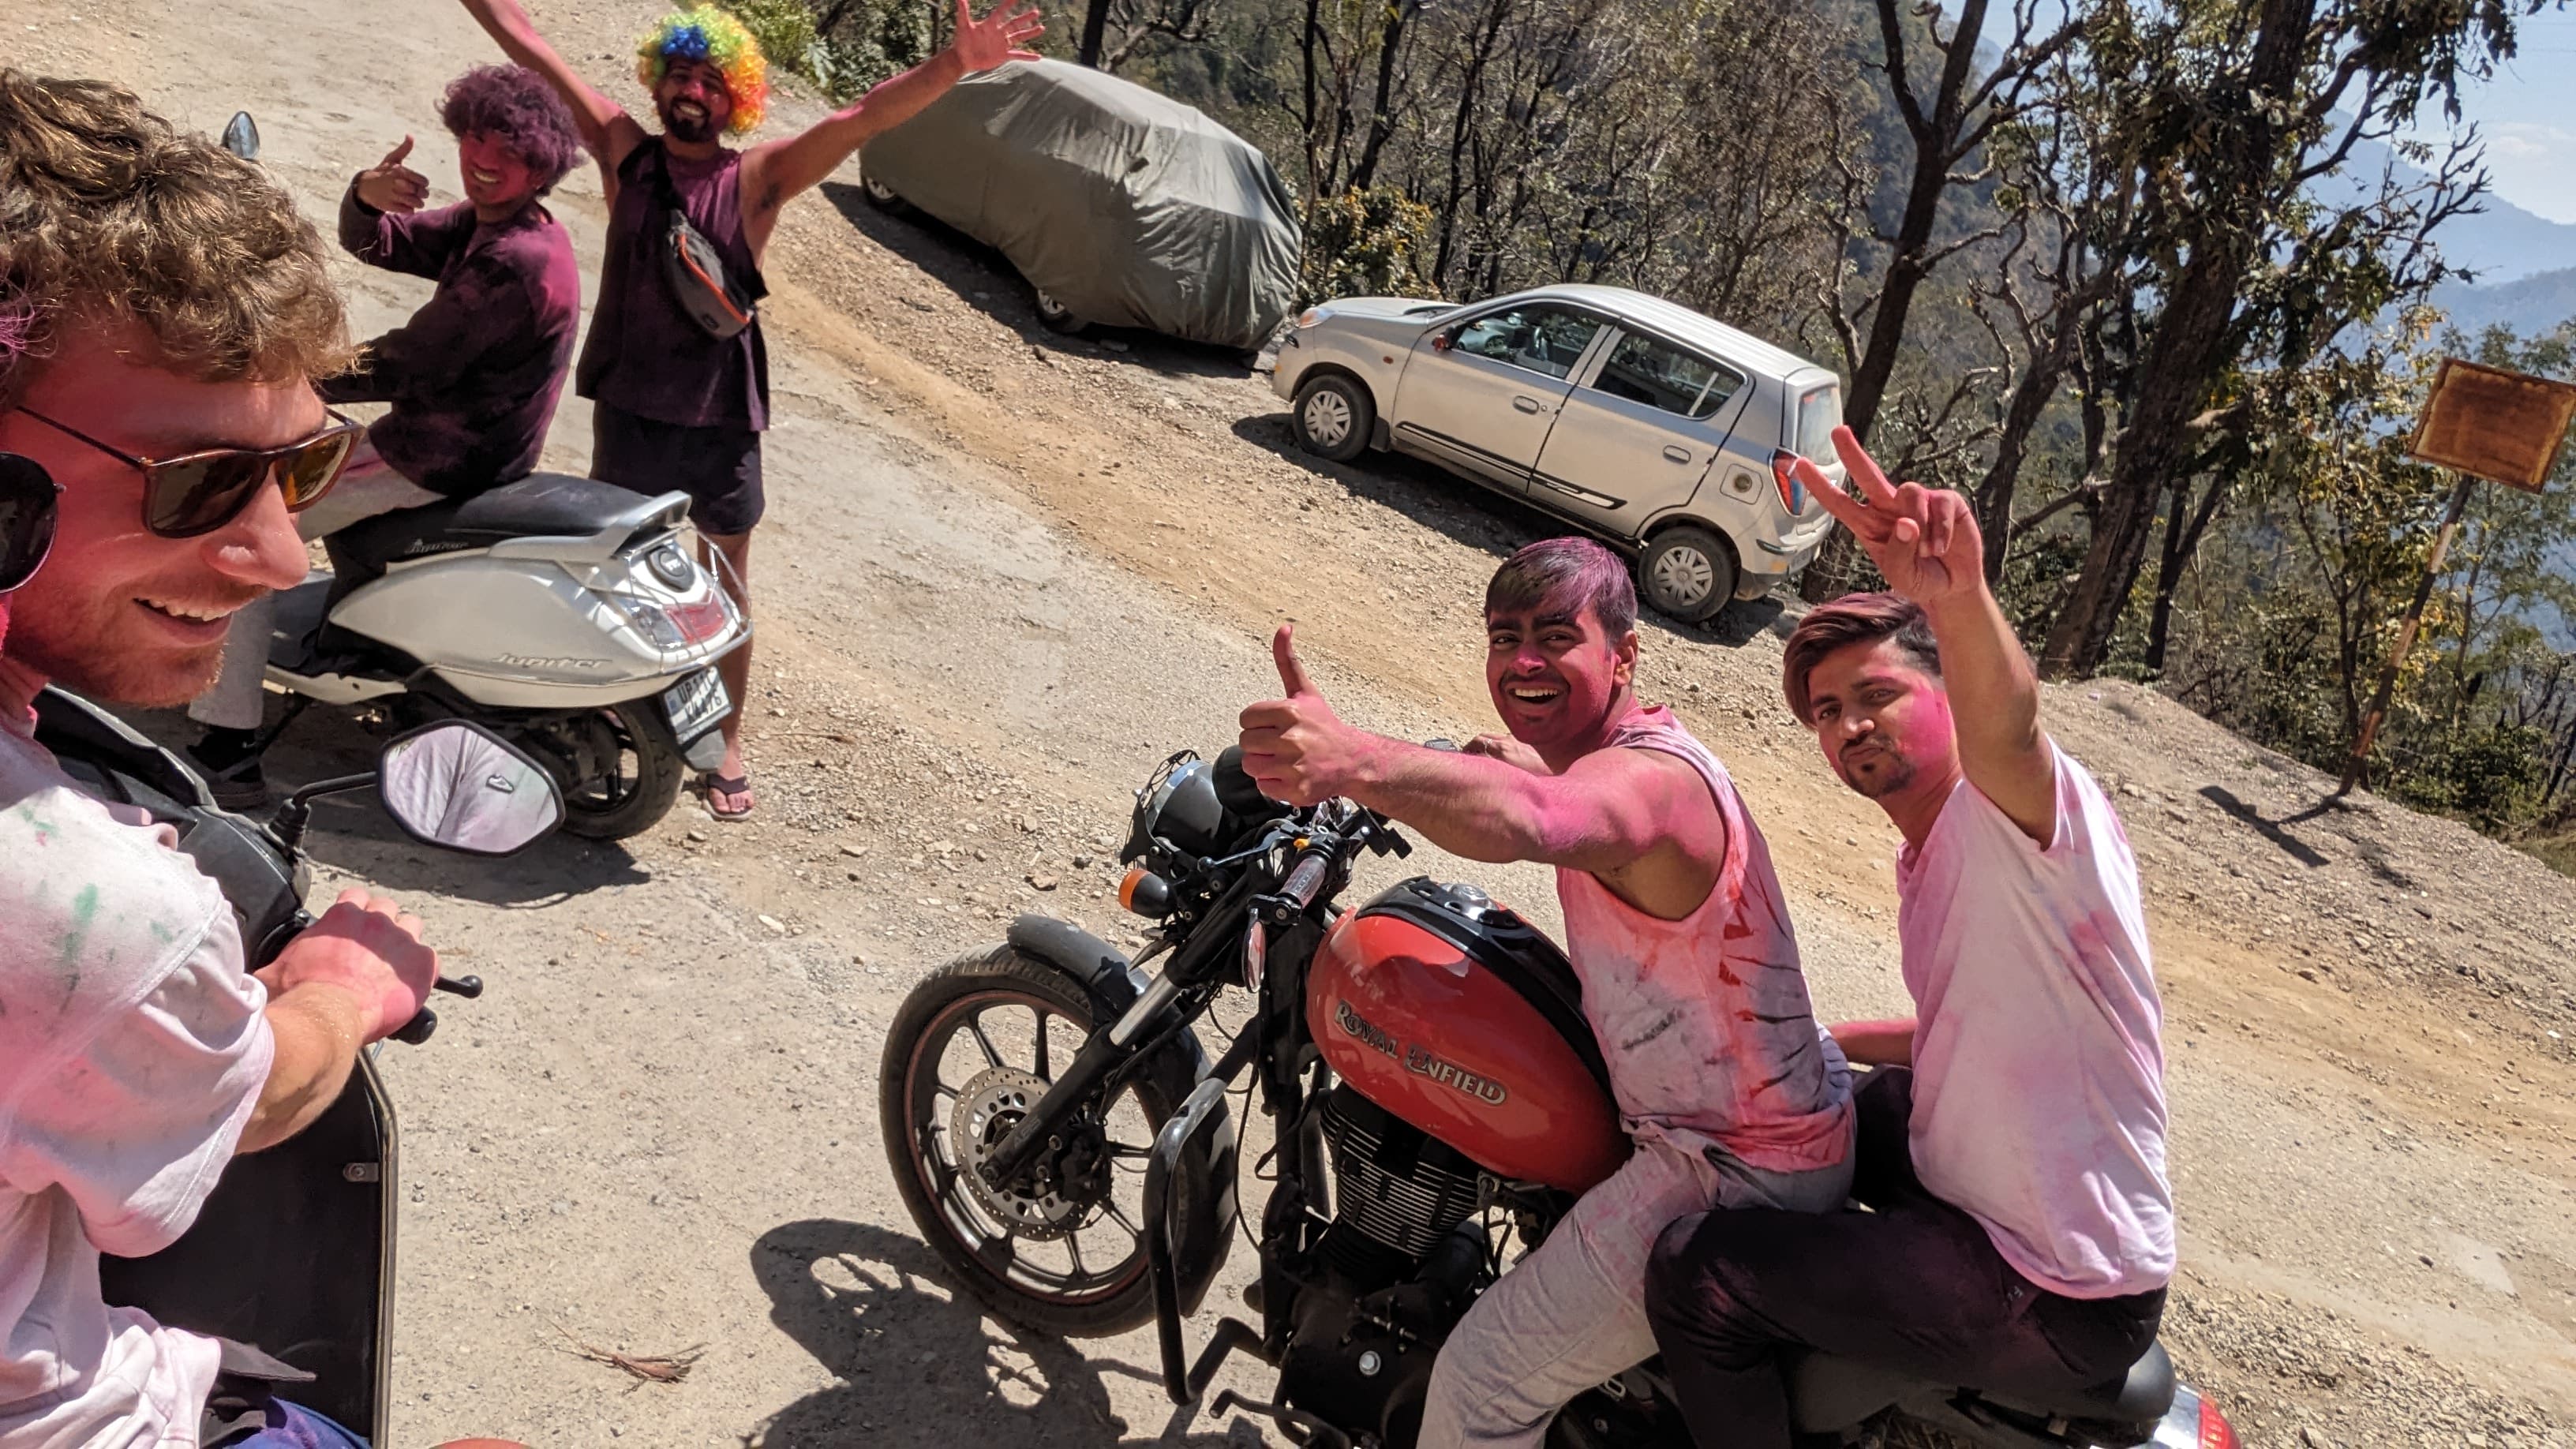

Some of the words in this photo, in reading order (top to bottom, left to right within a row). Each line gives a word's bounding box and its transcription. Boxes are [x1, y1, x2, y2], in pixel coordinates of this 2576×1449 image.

[492, 652, 612, 668] Jupiter
[1334, 998, 1399, 1060] ROYAL
[1404, 1042, 1507, 1105] ENFIELD
